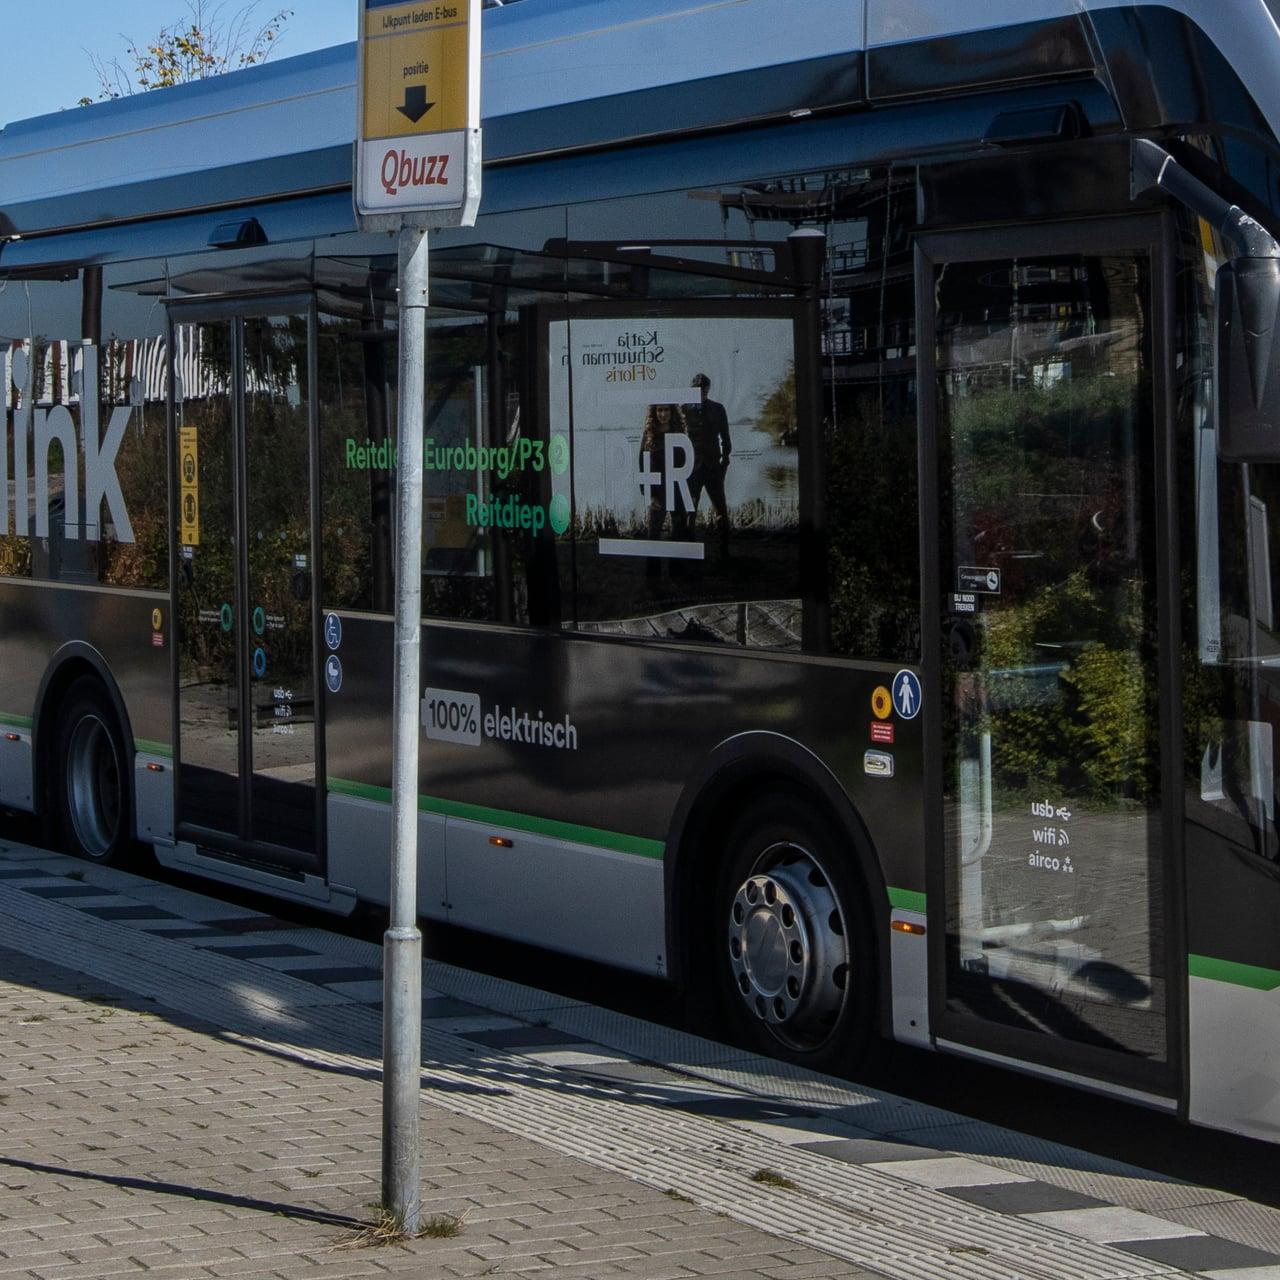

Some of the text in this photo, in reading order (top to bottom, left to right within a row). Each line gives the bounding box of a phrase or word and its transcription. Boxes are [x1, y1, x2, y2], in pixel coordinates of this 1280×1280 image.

[382, 6, 457, 29] IJkpunt laden E-bus
[403, 61, 429, 79] positie
[381, 149, 449, 196] Qbuzz
[346, 437, 399, 470] Reitdie
[466, 493, 545, 537] Reitdiep
[428, 699, 578, 750] 100% elektrisch
[1031, 799, 1053, 818] usb
[1032, 826, 1056, 845] wifi
[1028, 850, 1060, 871] airco
